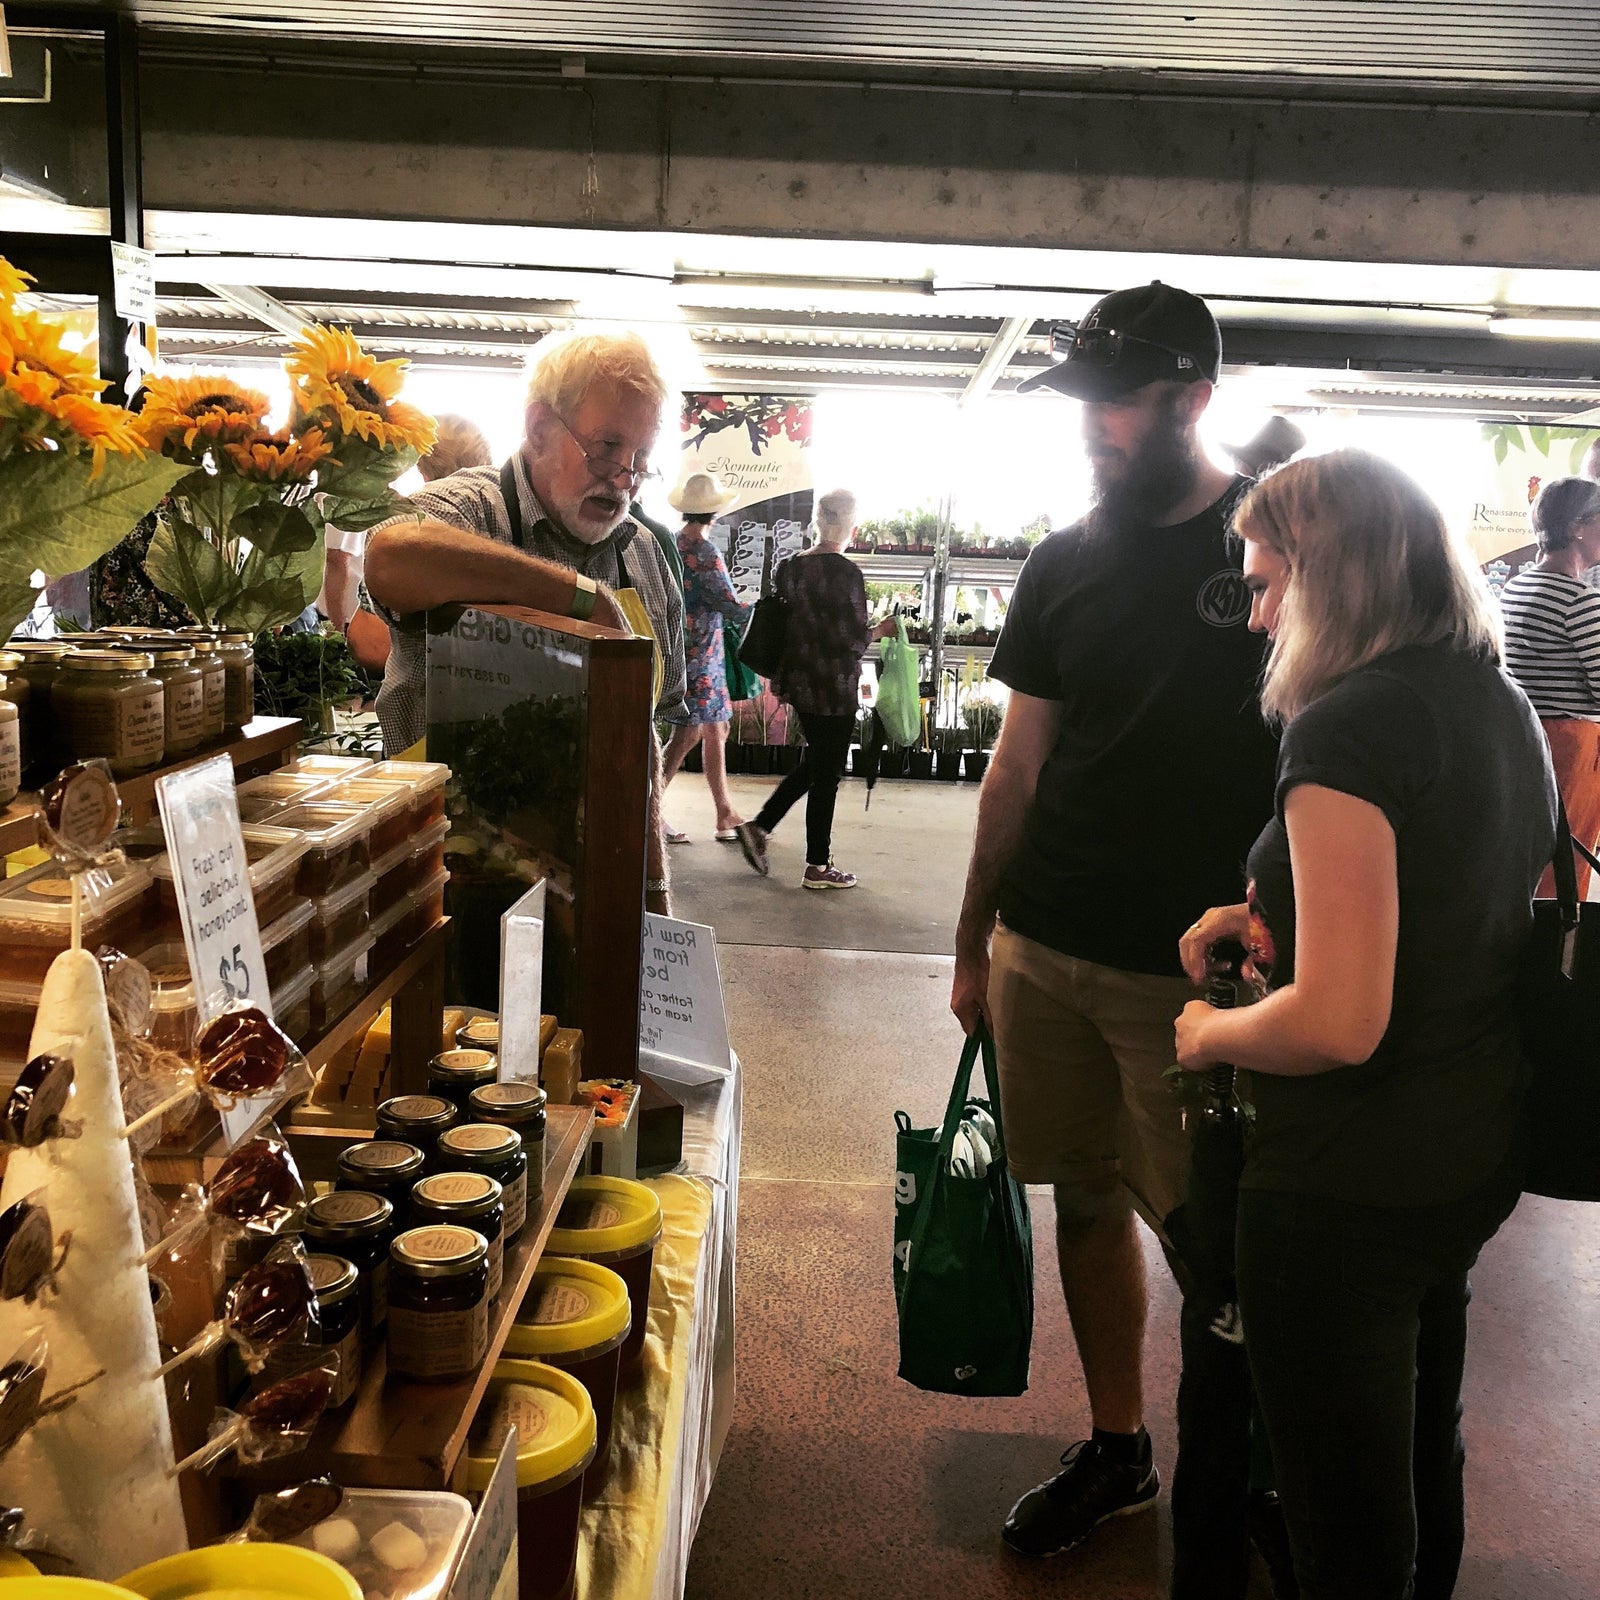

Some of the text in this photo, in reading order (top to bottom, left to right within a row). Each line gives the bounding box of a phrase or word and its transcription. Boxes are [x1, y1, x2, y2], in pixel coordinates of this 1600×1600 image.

[706, 456, 782, 473] Romantic
[1473, 503, 1527, 522] Renaissance
[218, 842, 234, 864] cut
[199, 873, 239, 908] delicious
[198, 894, 248, 942] honeycomb
[219, 944, 250, 1000] $5
